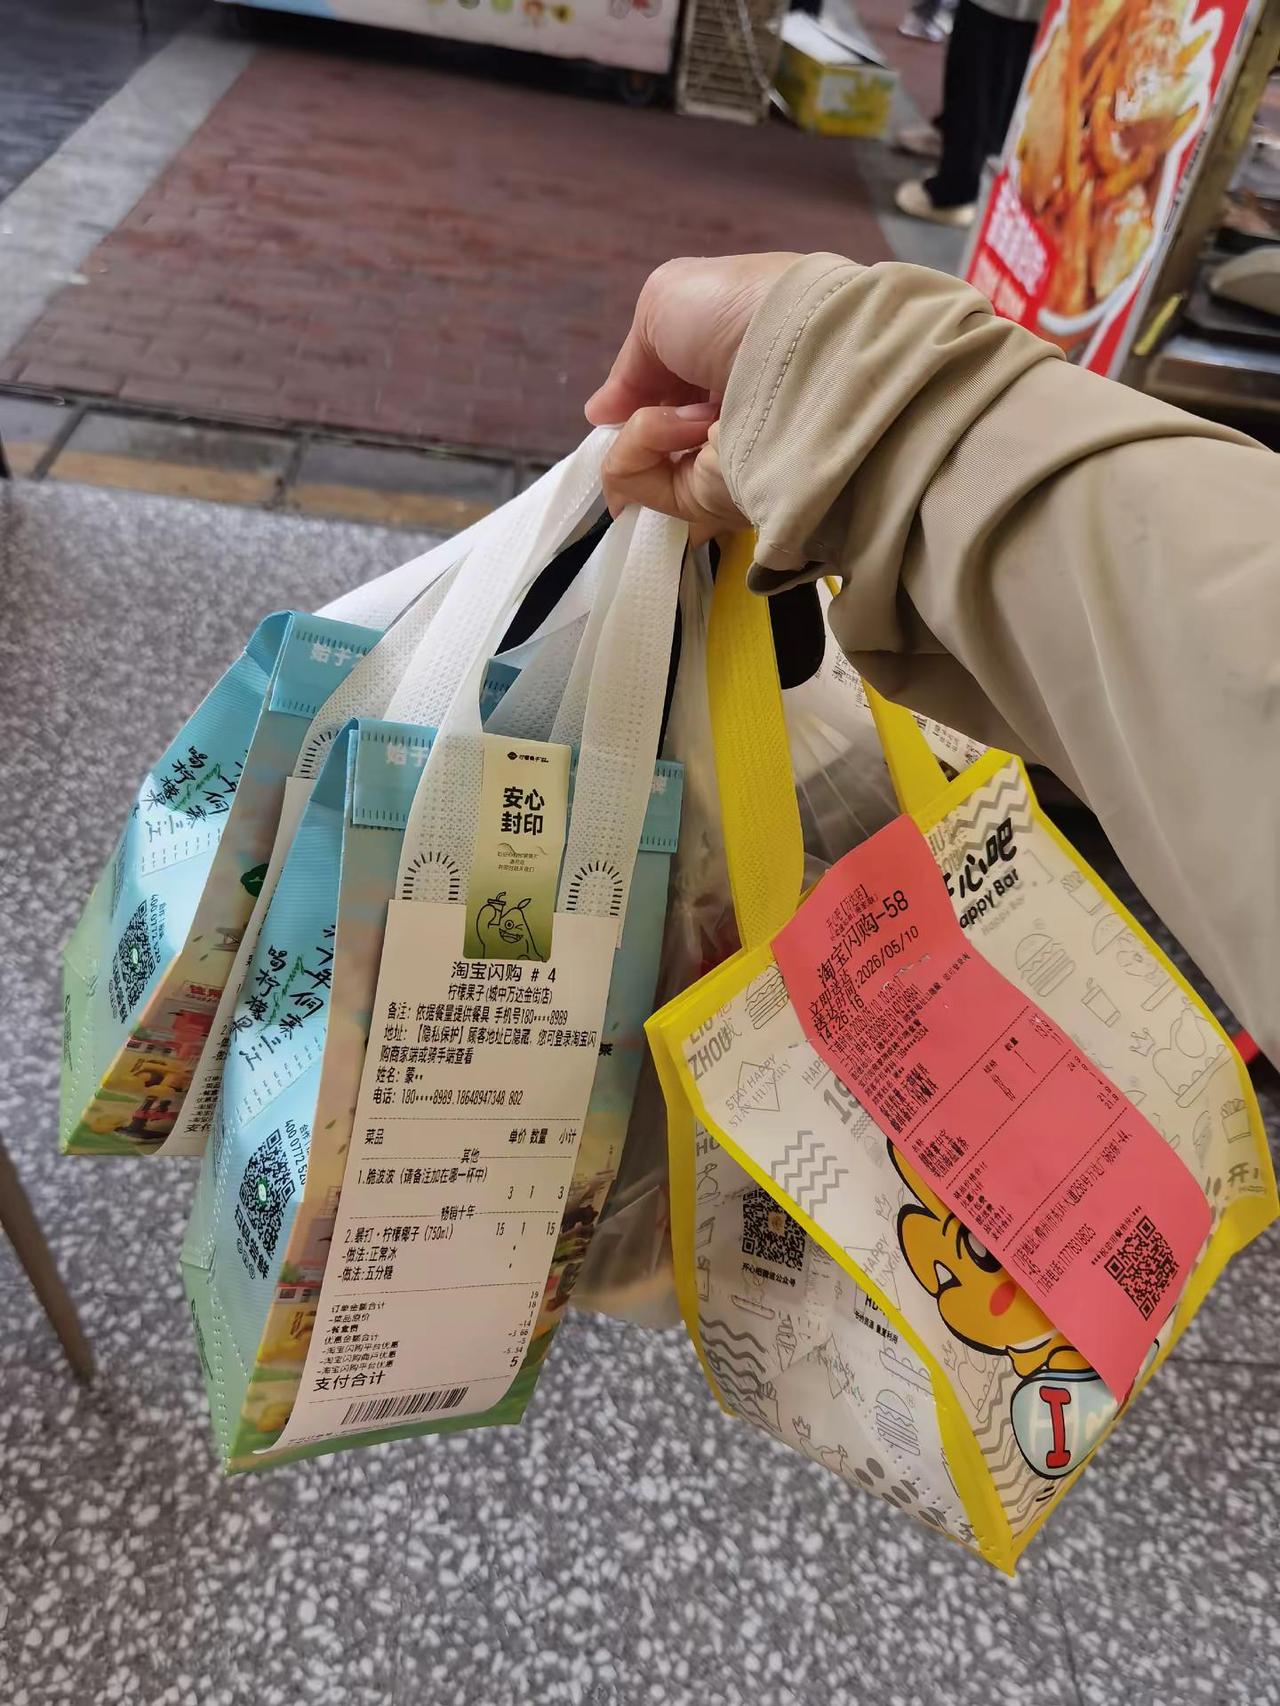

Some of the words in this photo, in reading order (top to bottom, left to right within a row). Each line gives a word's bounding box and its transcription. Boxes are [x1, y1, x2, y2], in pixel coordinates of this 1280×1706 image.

[502, 786, 545, 811] 安心
[501, 811, 543, 836] 封印
[960, 889, 994, 929] appy
[993, 868, 1019, 897] Bar
[817, 890, 909, 987] 淘宝闪购-58
[450, 961, 523, 982] 淘宝闪购
[531, 967, 540, 982] #
[547, 967, 557, 983] 4
[379, 1045, 474, 1065] 购商家端或骑手端查看
[364, 1128, 385, 1145] 菜品
[508, 1128, 526, 1144] 单价
[530, 1128, 548, 1144] 数量
[558, 1129, 577, 1145] 小计
[507, 1186, 514, 1200] 3
[558, 1185, 564, 1200] 3
[495, 1222, 505, 1236] 15
[546, 1222, 555, 1236] 15
[313, 1370, 386, 1392] 支付合计
[509, 1355, 519, 1368] 5
